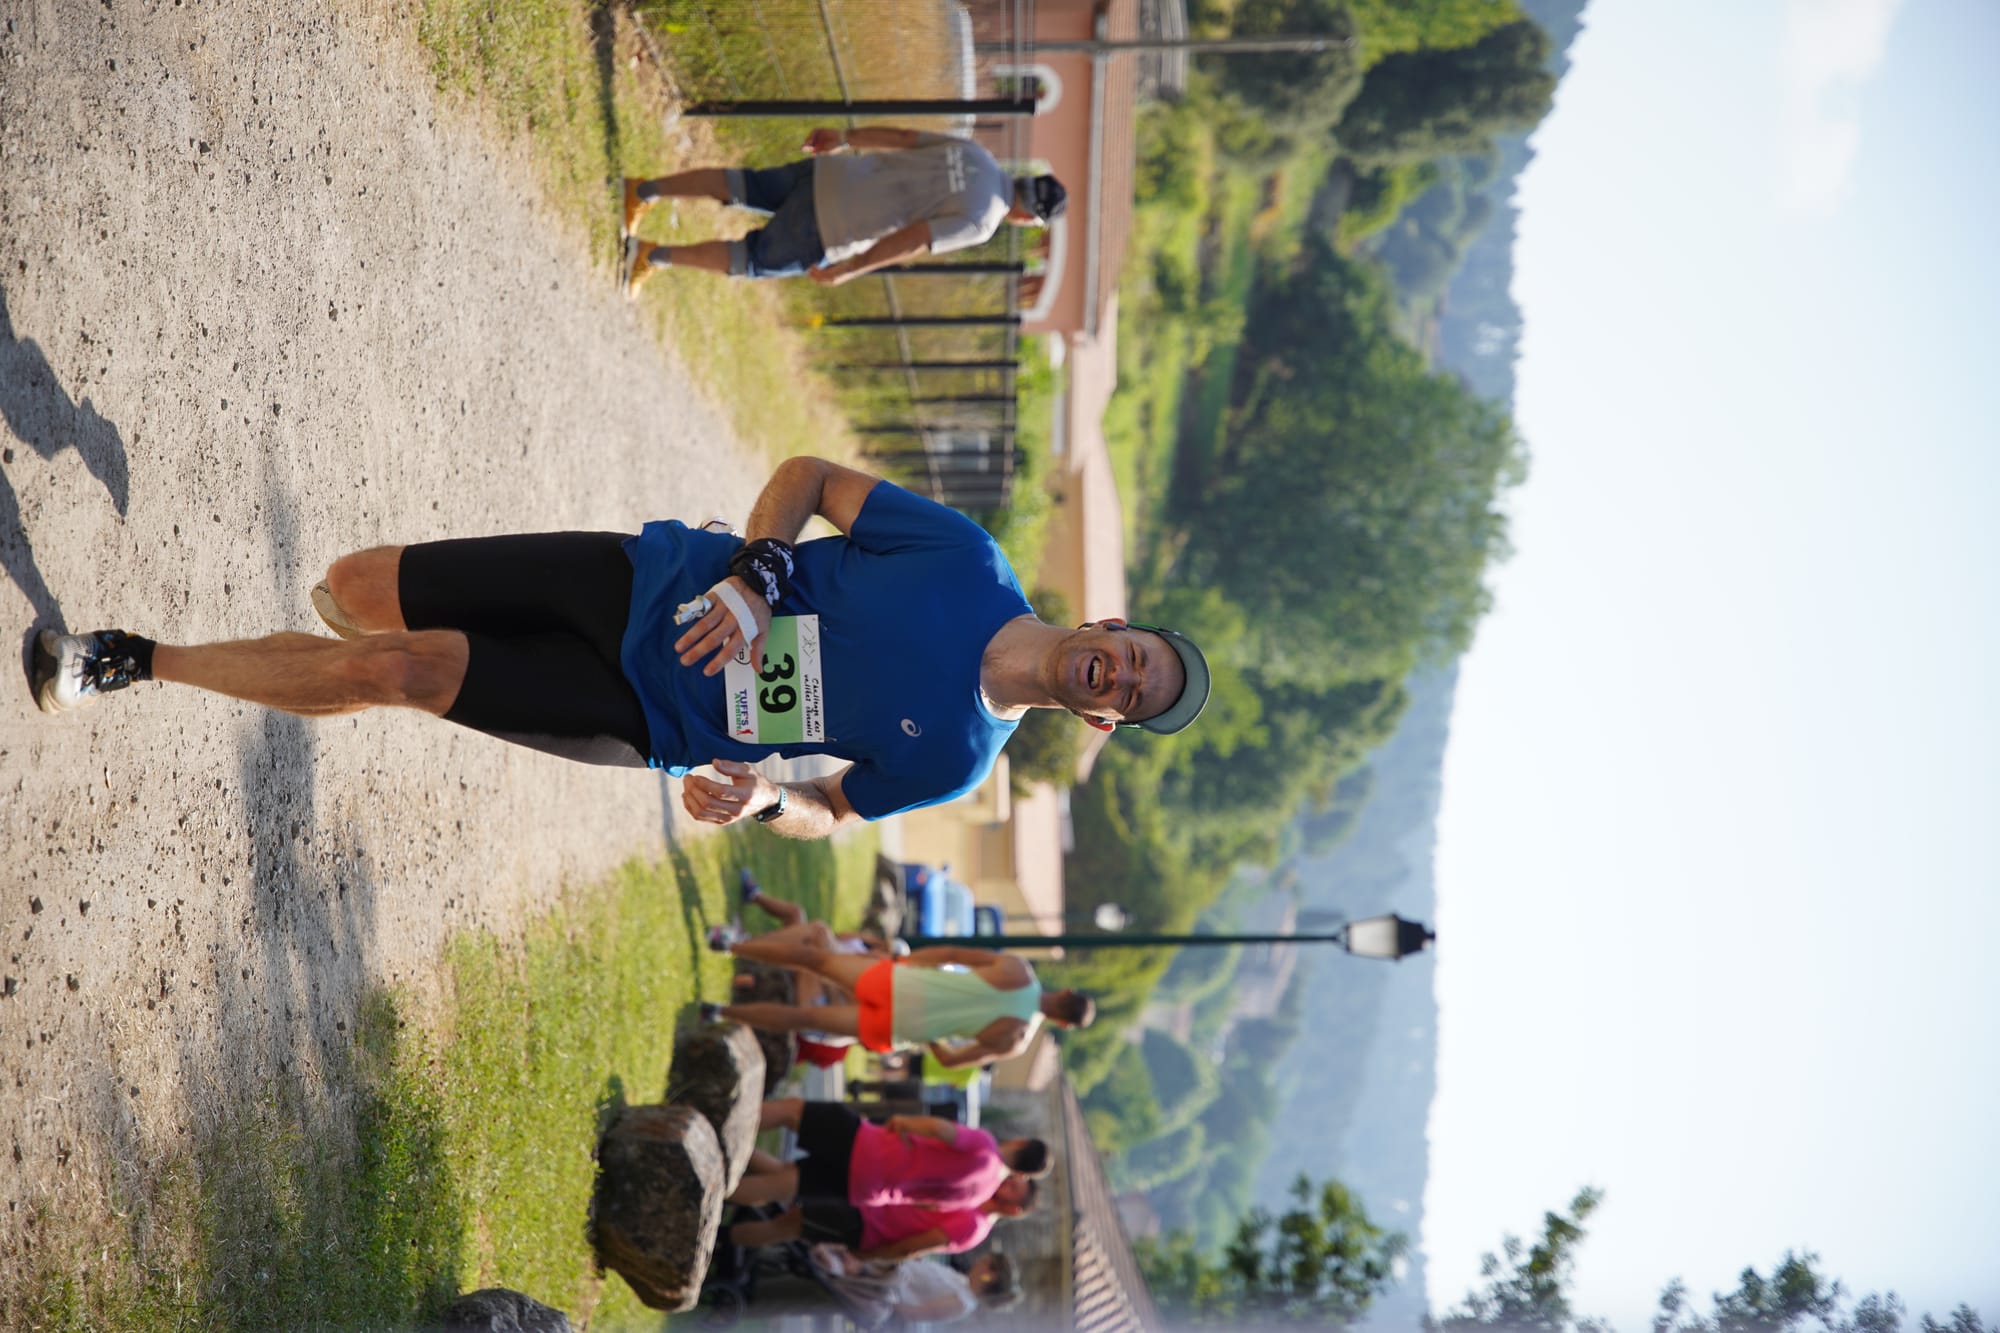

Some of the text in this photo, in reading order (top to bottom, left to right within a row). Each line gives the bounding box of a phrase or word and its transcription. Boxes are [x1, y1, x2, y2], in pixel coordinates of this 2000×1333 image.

[759, 653, 797, 713] 39
[811, 678, 820, 717] Challenge
[739, 688, 749, 726] TUFF'S
